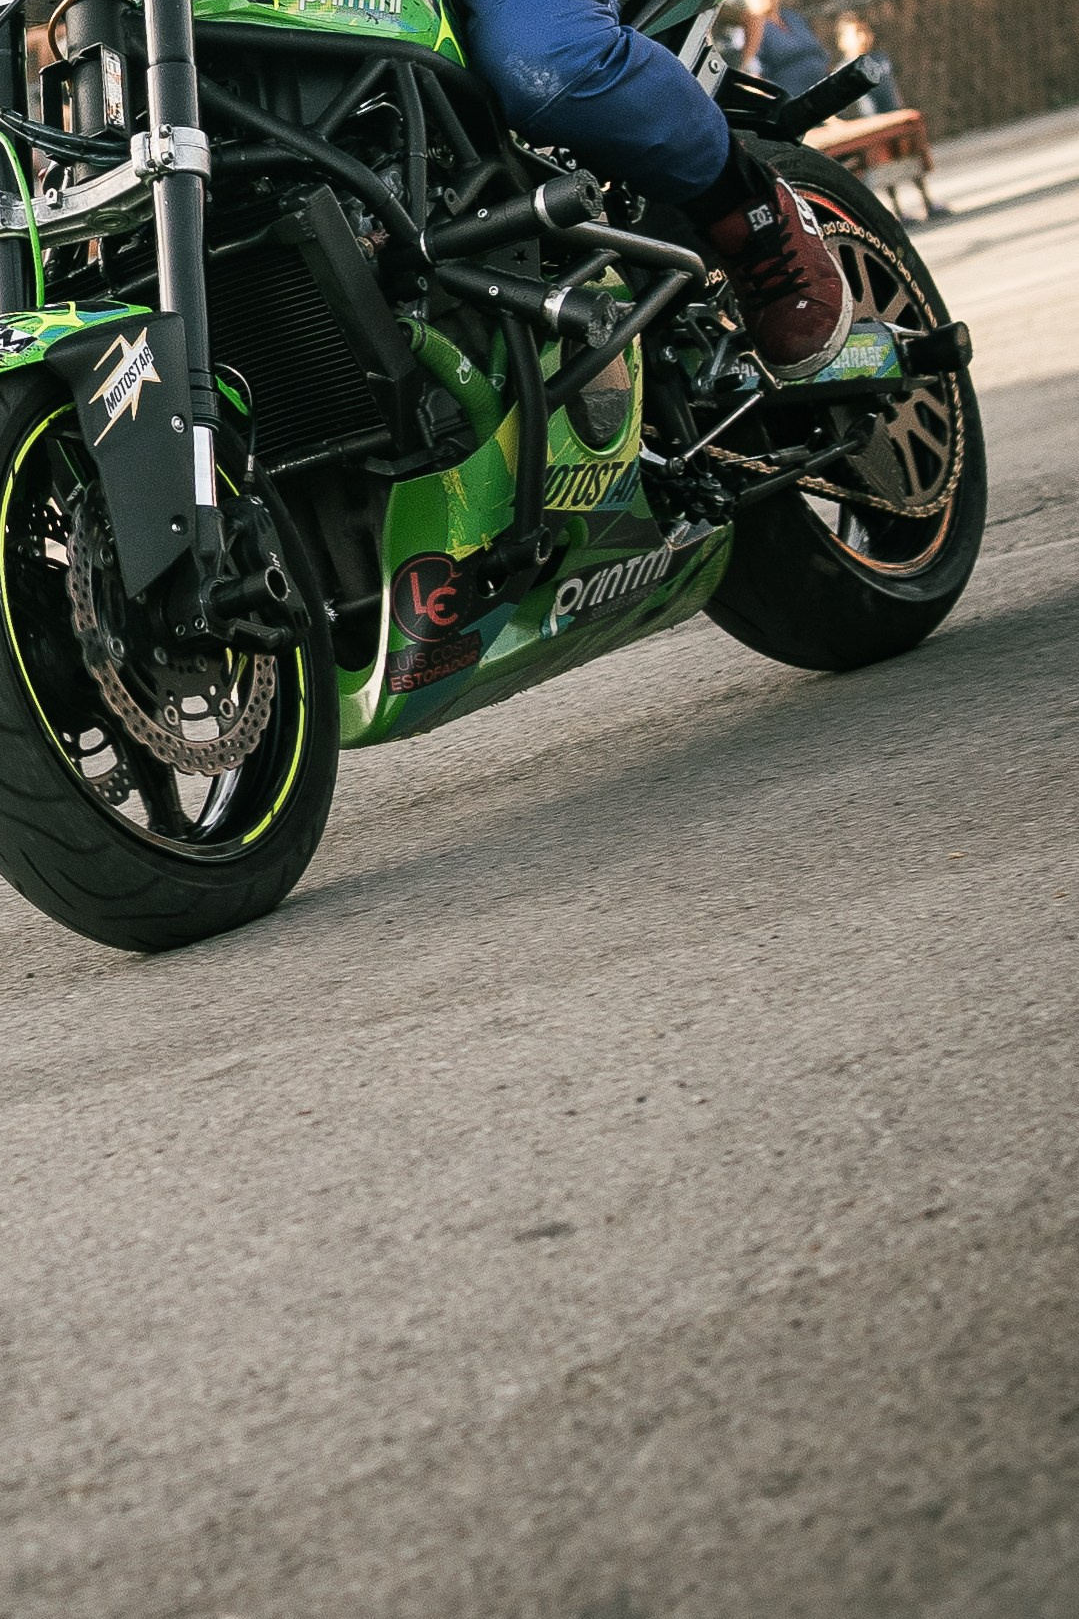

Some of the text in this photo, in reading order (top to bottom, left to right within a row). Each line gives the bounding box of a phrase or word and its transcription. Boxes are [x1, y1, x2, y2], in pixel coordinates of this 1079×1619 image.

[105, 345, 154, 415] MOTOSTAR
[544, 461, 640, 507] OTOSTAR
[390, 649, 480, 692] ESTOFADOR
